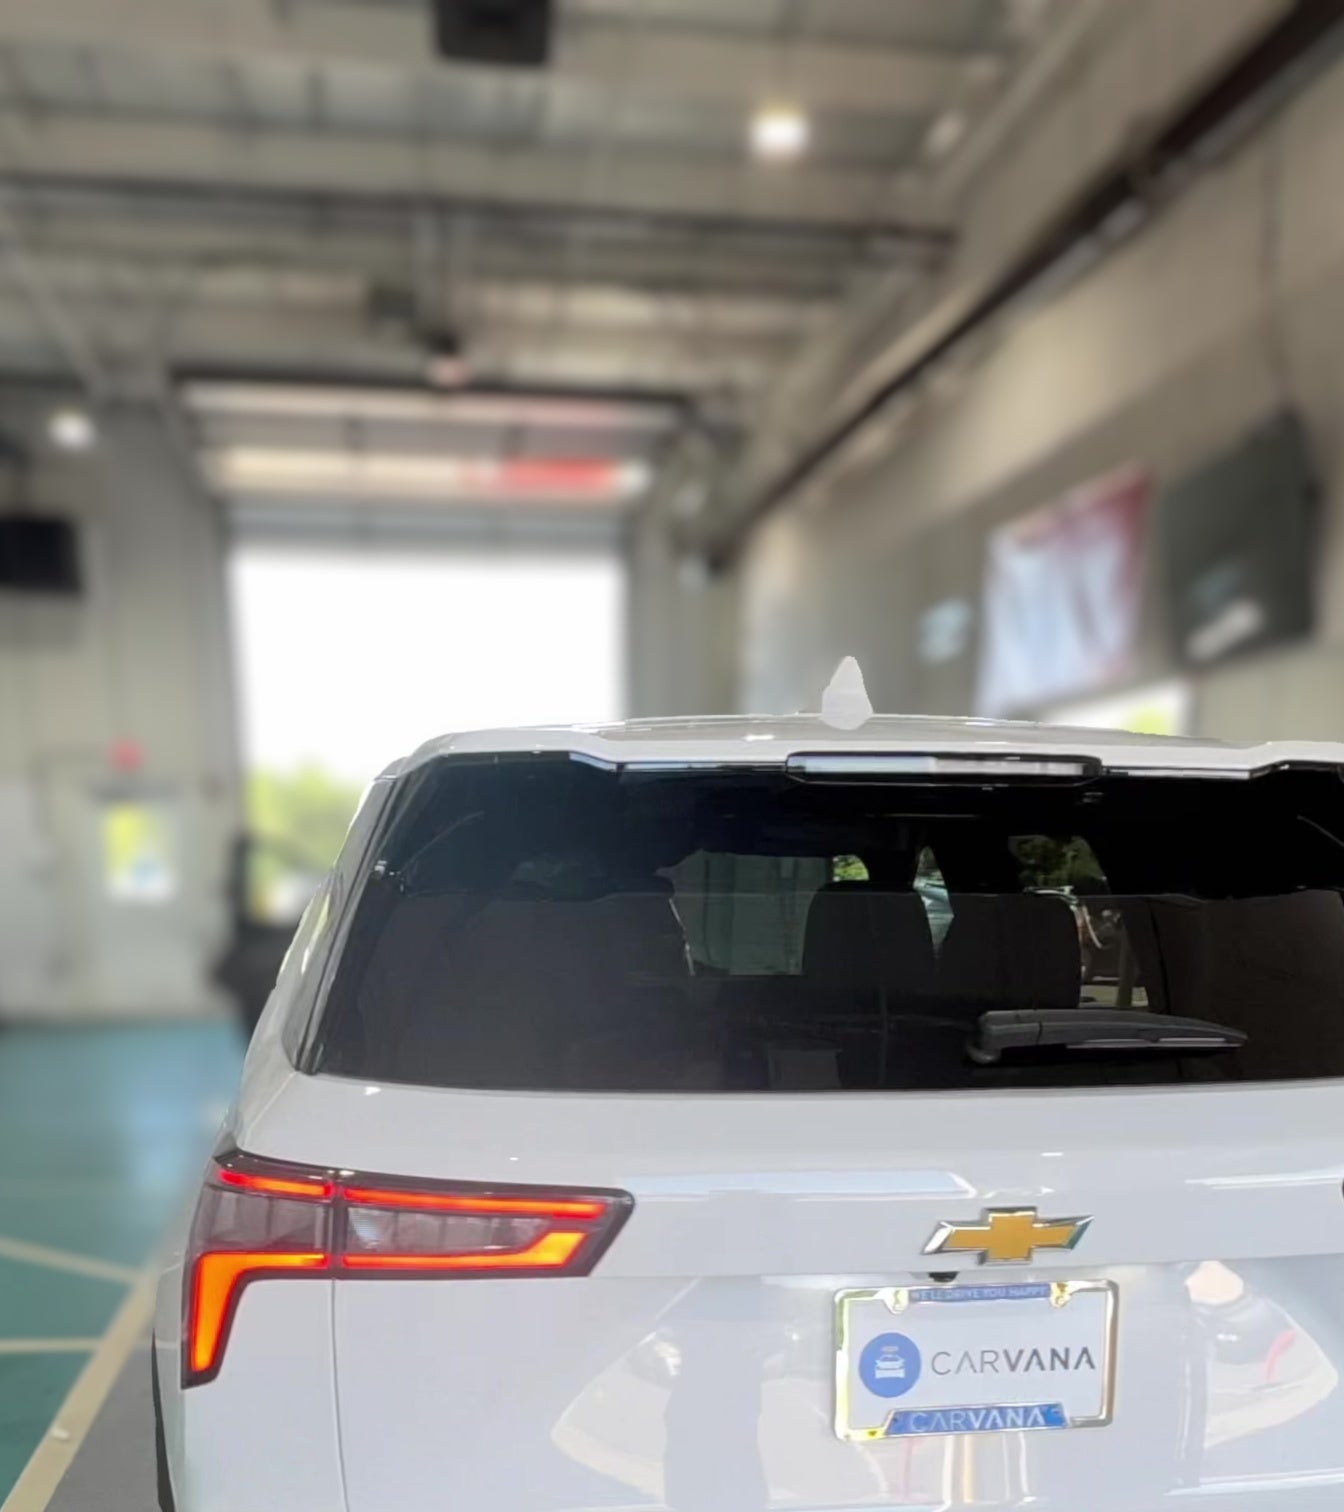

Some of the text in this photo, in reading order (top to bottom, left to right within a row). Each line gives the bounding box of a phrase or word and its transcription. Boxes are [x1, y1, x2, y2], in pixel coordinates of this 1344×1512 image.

[983, 1288, 1006, 1299] YOU
[931, 1346, 1096, 1376] CARVANA
[910, 1406, 1046, 1432] CARVANA
